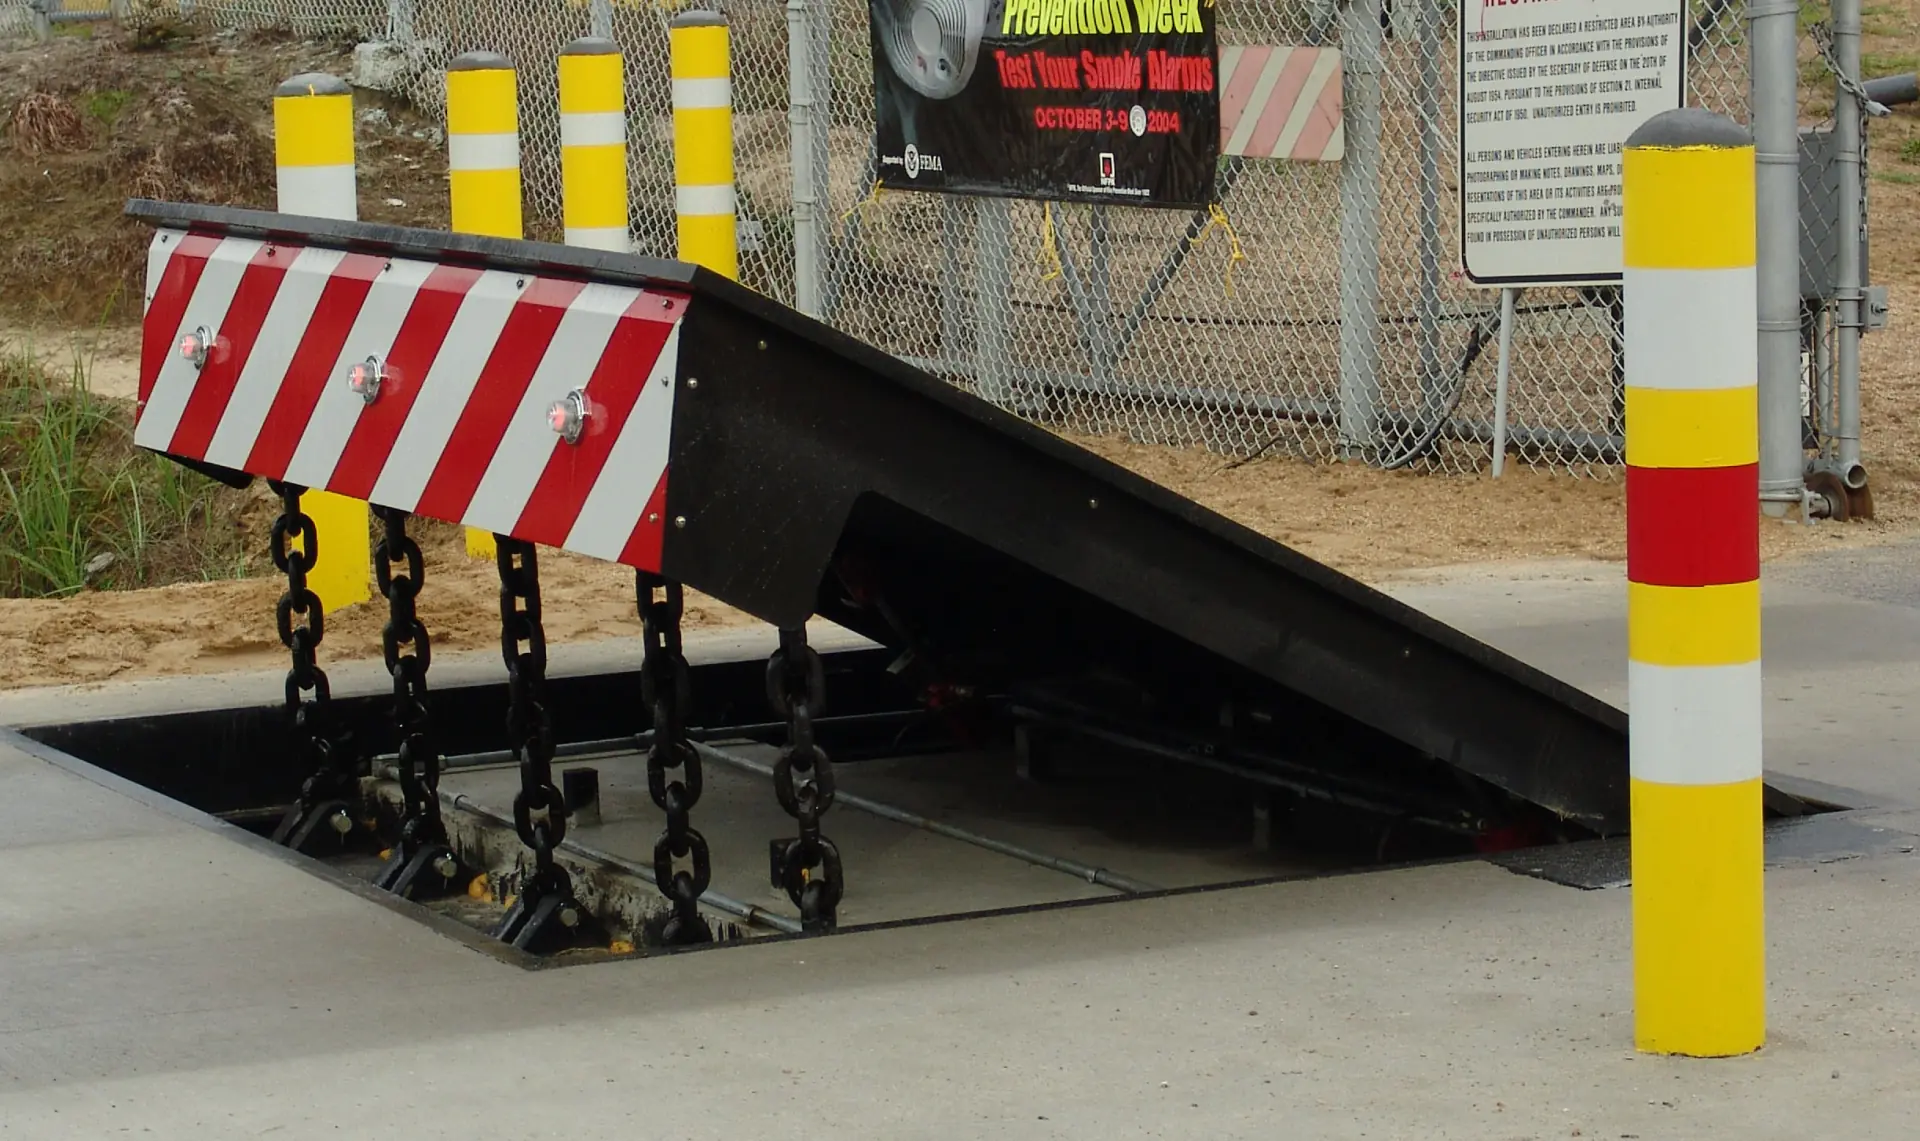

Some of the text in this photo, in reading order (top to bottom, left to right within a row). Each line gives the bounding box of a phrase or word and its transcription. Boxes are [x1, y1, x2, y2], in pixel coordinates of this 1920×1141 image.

[1002, 0, 1203, 35] Prevention Week
[1519, 26, 1530, 38] HAS
[1532, 25, 1546, 36] BEEN
[1548, 22, 1576, 36] DECLARED
[1578, 22, 1582, 32] A
[1584, 18, 1618, 32] RESTRICTED
[1620, 16, 1635, 28] AREA
[1638, 16, 1645, 28] BY
[1647, 12, 1678, 26] AUTHORITY
[1467, 34, 1668, 62] OF THE COMMANDING OFFICER IN ACCORDANCE WITH THE PROVISIONS OF
[994, 50, 1214, 92] Test Your Smoke Alarms
[1467, 56, 1666, 82] THE DIRECTIVE ISSUED BY THE SECRETARY OF DEFENSE ON THE 20TH OF
[1467, 91, 1487, 103] AUGUST
[1504, 87, 1532, 100] PURSUANT
[1534, 86, 1541, 98] TO
[1543, 86, 1552, 96] THE
[1555, 82, 1588, 96] PROVISIONS
[1590, 82, 1596, 94] OF
[1599, 80, 1622, 92] SECTION
[1634, 78, 1662, 90] INTERNAL
[1035, 107, 1180, 132] OCTOBER 3-9 2004
[1467, 111, 1492, 124] SECURITY
[1493, 110, 1504, 122] ACT
[1506, 110, 1512, 120] OF
[1532, 105, 1574, 119] UNAUTHORIZED
[1576, 104, 1593, 116] ENTRY
[1596, 103, 1600, 114] IS
[1603, 100, 1636, 114] PROHIBITED.
[920, 154, 942, 171] FEMA
[1467, 152, 1476, 162] ALL
[1478, 150, 1502, 162] PERSONS
[1504, 150, 1514, 160] AND
[1517, 148, 1542, 159] VEHICLES
[1544, 146, 1570, 158] ENTERING
[1572, 144, 1592, 156] HEREIN
[1595, 143, 1606, 154] ARE
[1467, 170, 1508, 182] PHOTOGRAPHING
[1510, 170, 1518, 180] OR
[1520, 168, 1540, 180] MAKING
[1467, 190, 1504, 203] RESENTATIONS
[1507, 190, 1514, 201] OF
[1516, 189, 1527, 200] THIS
[1530, 188, 1543, 200] AREA
[1546, 188, 1552, 199] OR
[1554, 187, 1564, 198] ITS
[1566, 186, 1594, 198] ACTIVITIES
[1597, 184, 1608, 196] ARE
[1467, 212, 1501, 224] SPECIFICALLY
[1504, 210, 1536, 222] AUTHORIZED
[1538, 209, 1544, 220] BY
[1547, 208, 1556, 220] THE
[1600, 206, 1611, 217] ANY
[1467, 226, 1620, 242] FOUND IN POSSESSION OF UNAUTHORIZED PERSONS WILL
